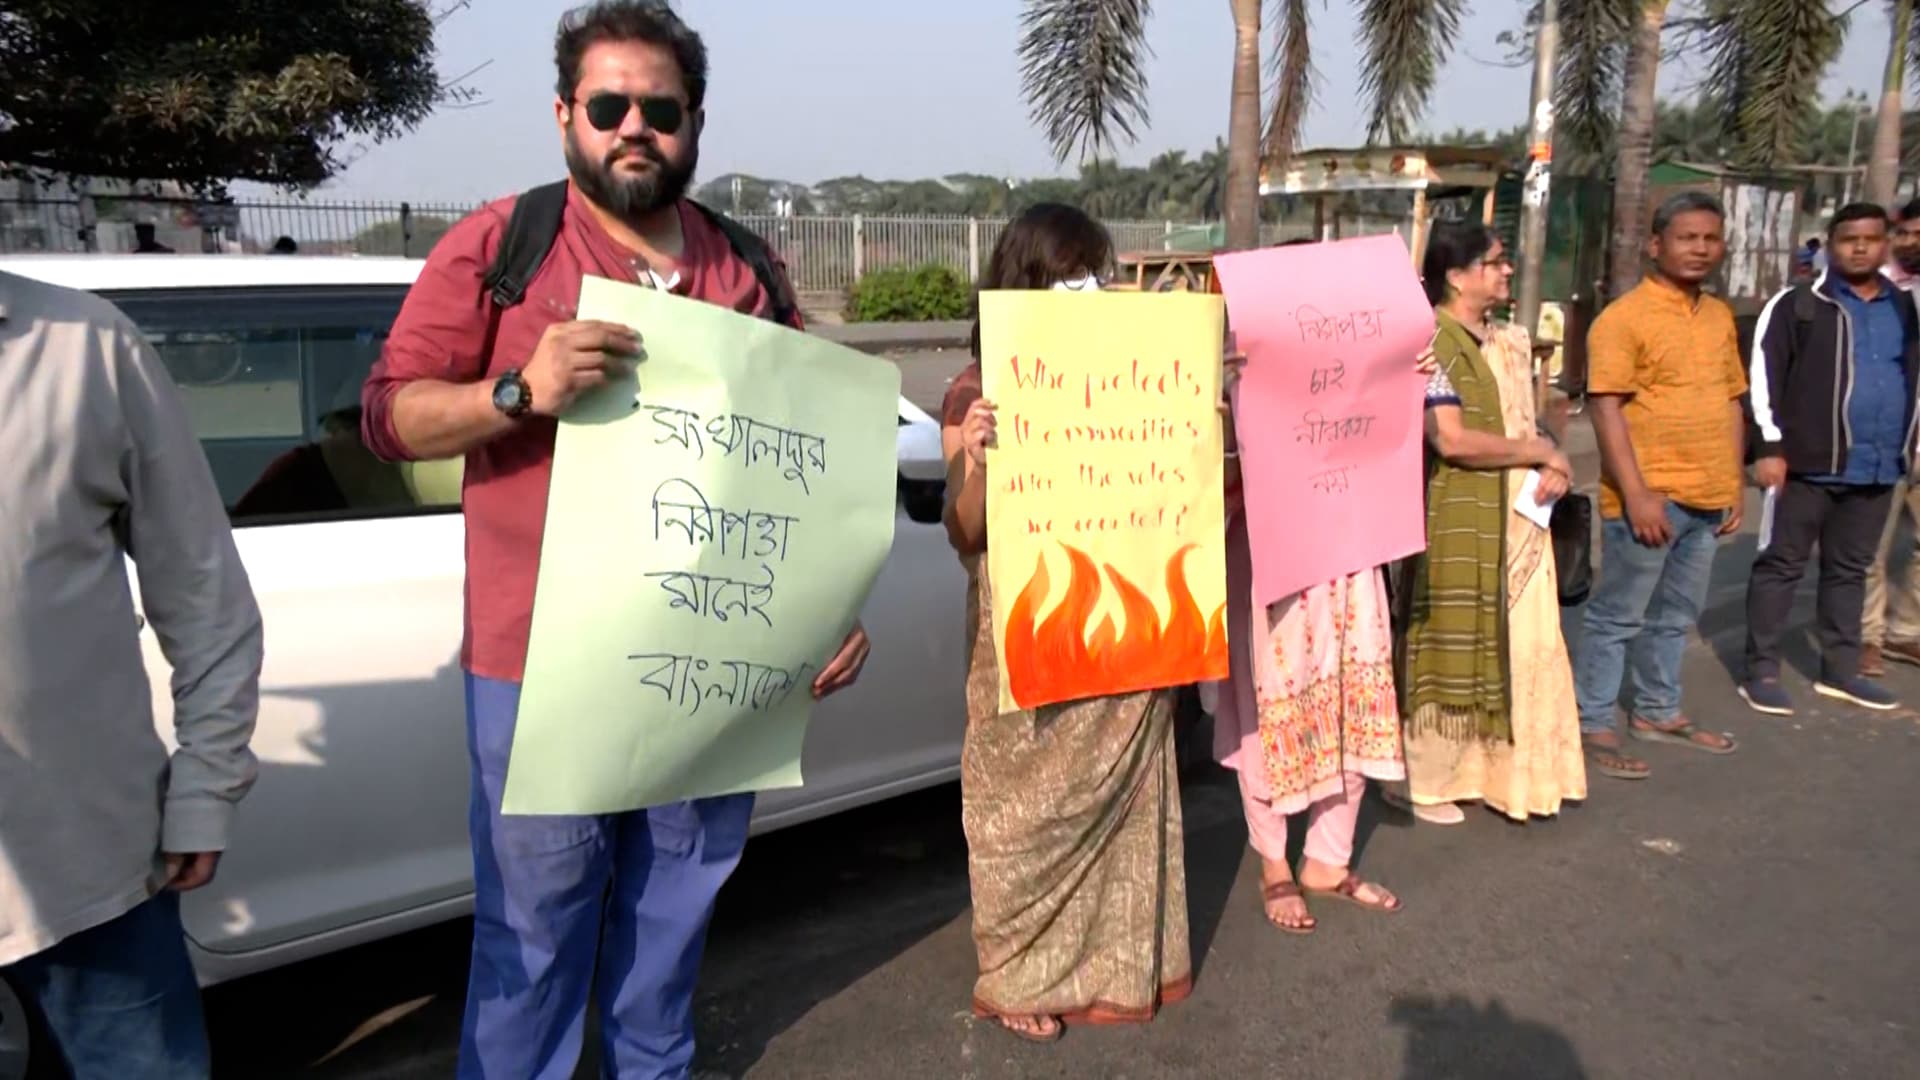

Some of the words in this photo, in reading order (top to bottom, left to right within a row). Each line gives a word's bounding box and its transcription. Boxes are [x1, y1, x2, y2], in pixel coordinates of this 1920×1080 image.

[1310, 359, 1345, 394] চাই
[652, 478, 799, 561] নিরাপত্তা
[643, 563, 775, 627] মানেই
[628, 653, 815, 716] বাংলাদেশ
